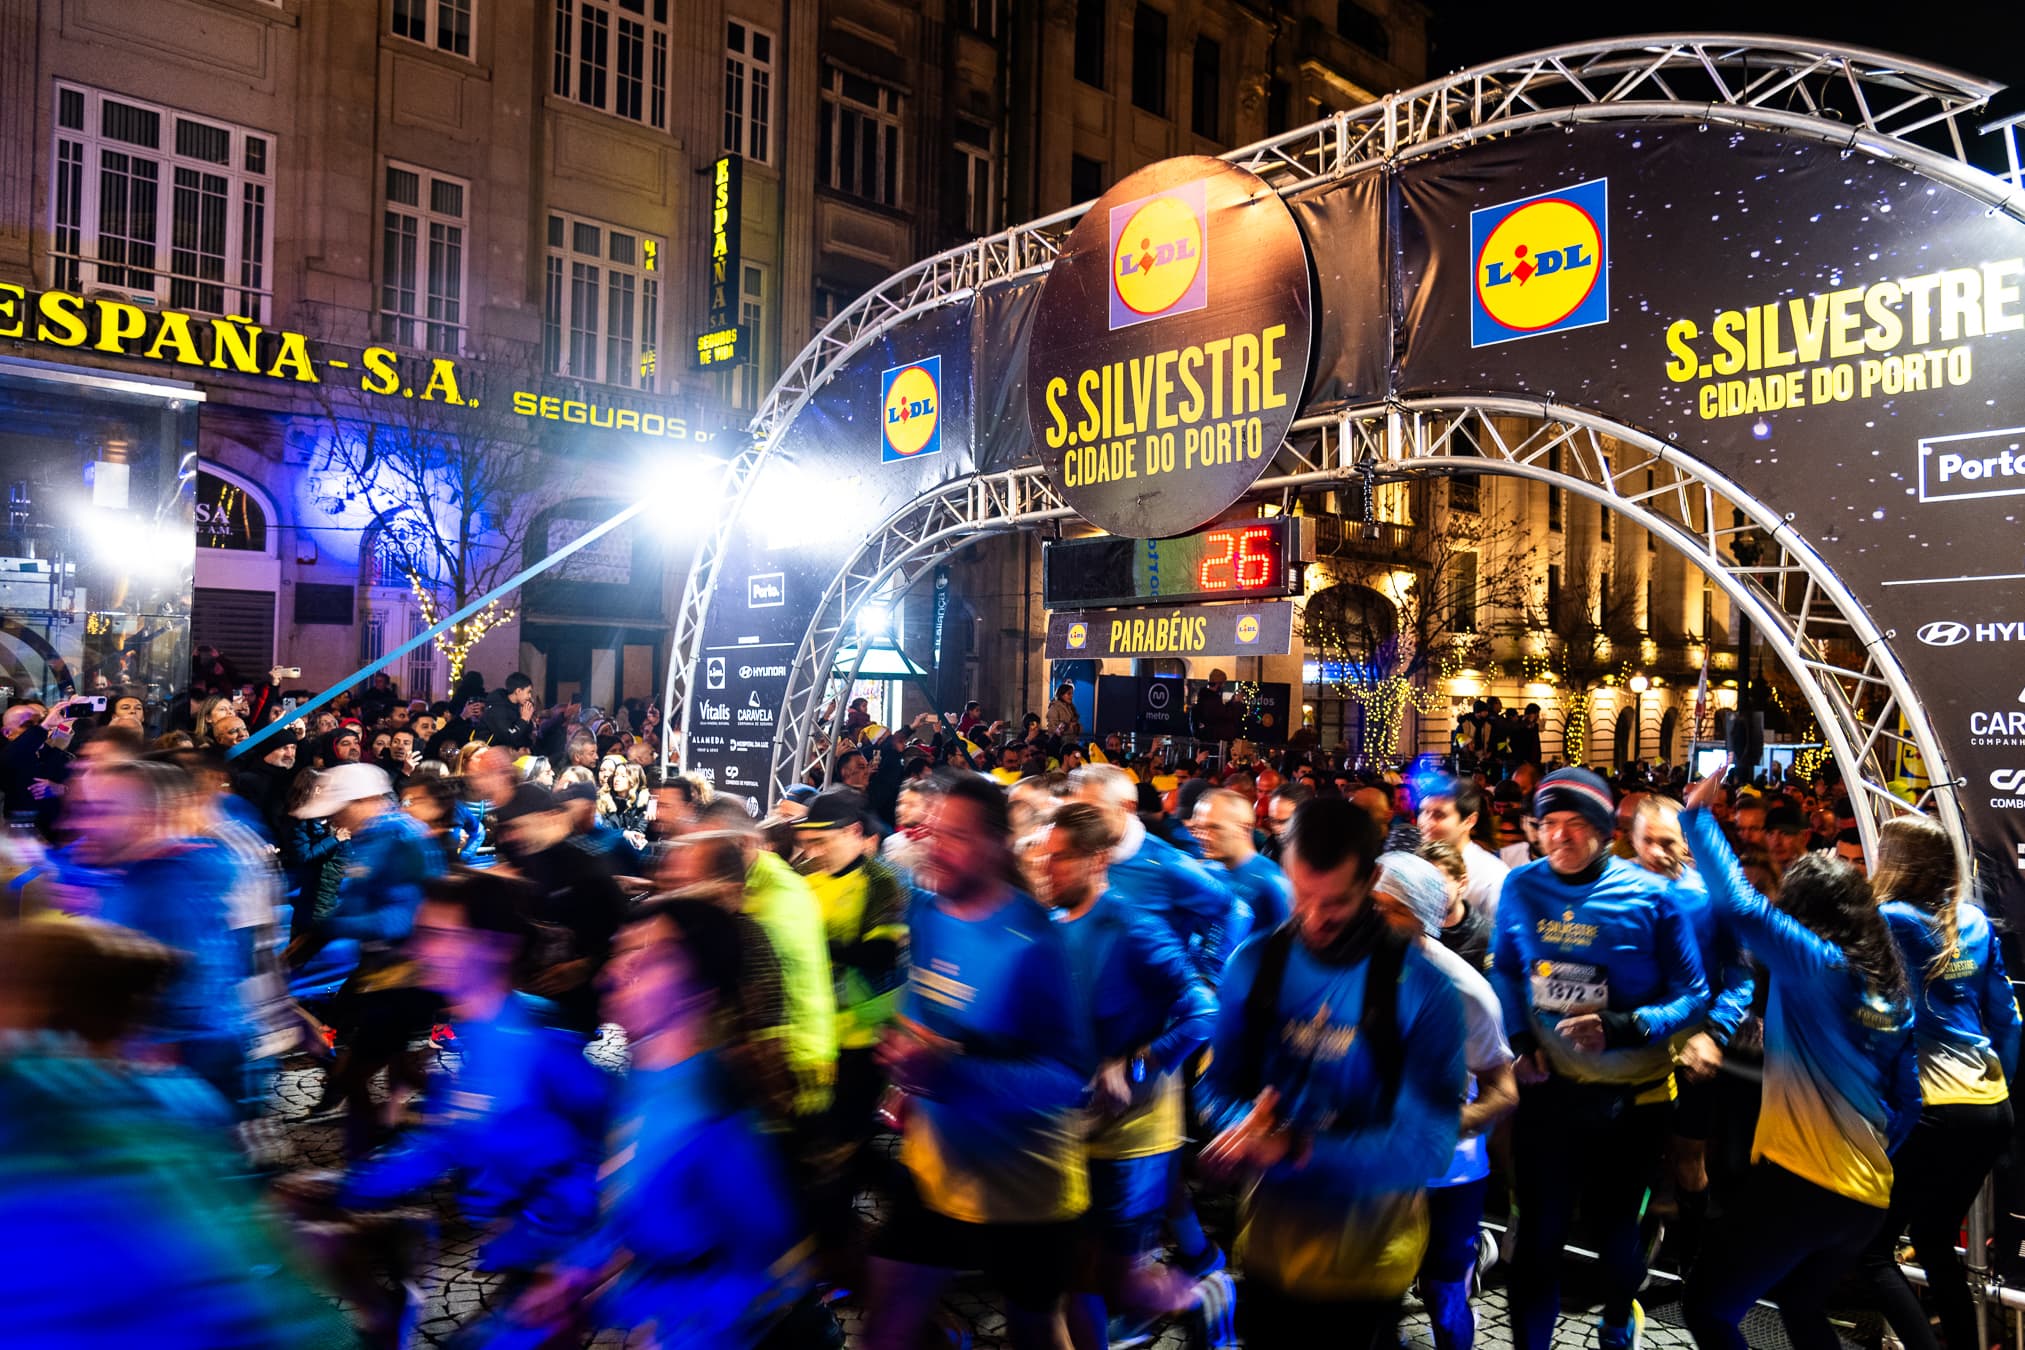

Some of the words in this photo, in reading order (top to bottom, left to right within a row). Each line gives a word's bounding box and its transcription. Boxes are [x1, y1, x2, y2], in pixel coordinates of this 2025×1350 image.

[1665, 257, 2025, 383] S.SILVESTRE
[361, 346, 480, 409] S.A.
[1045, 323, 1287, 449] S.SILVESTRE
[1699, 370, 1806, 420] CIDADE
[1811, 363, 1854, 406] DO
[1860, 345, 1972, 398] PORTO
[513, 391, 687, 440] SEGUROS
[1064, 438, 1138, 488] CIDADE
[1146, 432, 1175, 476] DO
[1185, 416, 1263, 470] PORTO
[1200, 528, 1268, 590] 26
[1109, 611, 1207, 653] PARABÉNS
[699, 698, 730, 720] Vitalis
[737, 709, 773, 721] CARAVELA
[1146, 711, 1170, 721] metro
[692, 736, 725, 744] ALAMEDA
